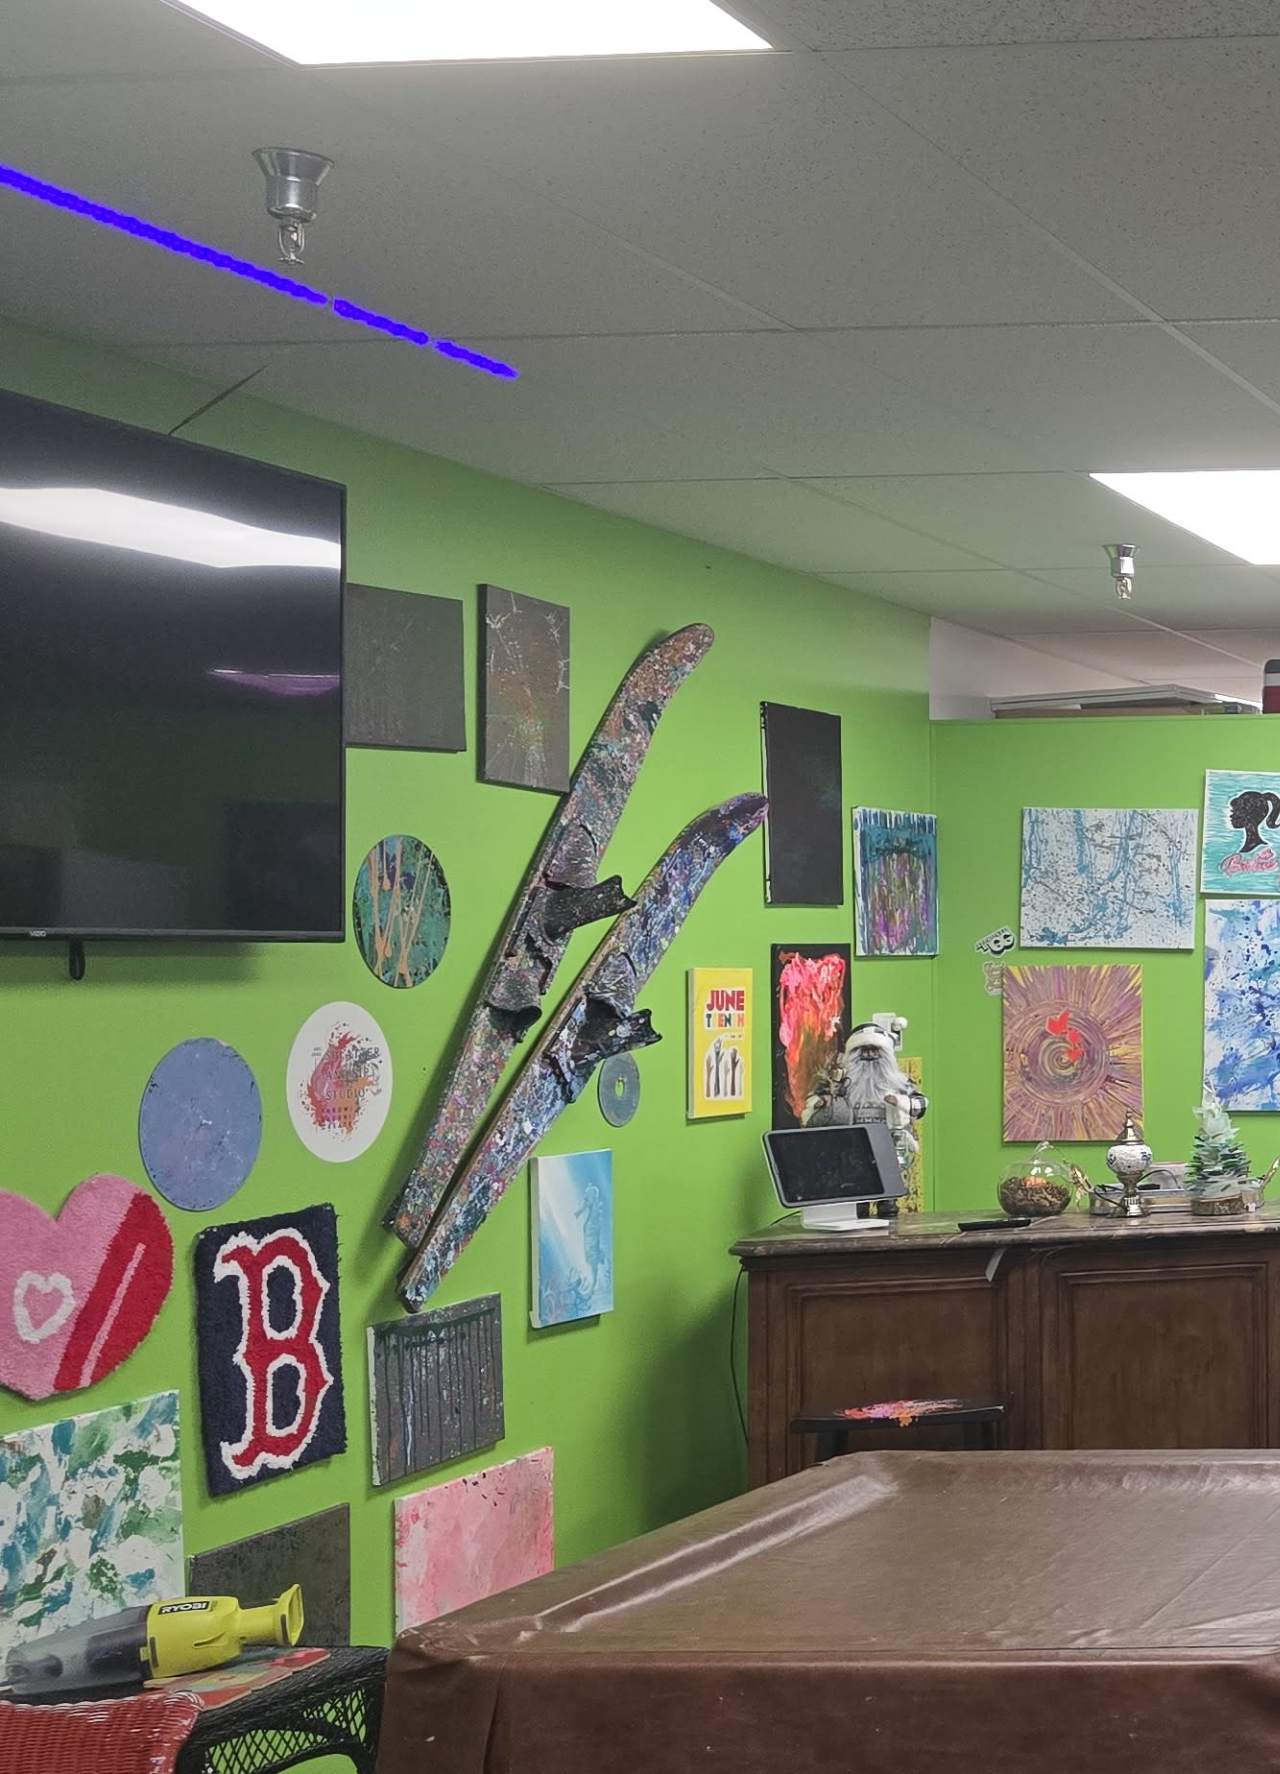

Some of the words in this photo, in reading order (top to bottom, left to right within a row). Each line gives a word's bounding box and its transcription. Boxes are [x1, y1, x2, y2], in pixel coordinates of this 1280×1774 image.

[706, 990, 745, 1011] JUNE
[327, 1087, 366, 1101] STUDIO
[213, 1227, 334, 1479] B
[161, 1602, 207, 1614] RYOBI
